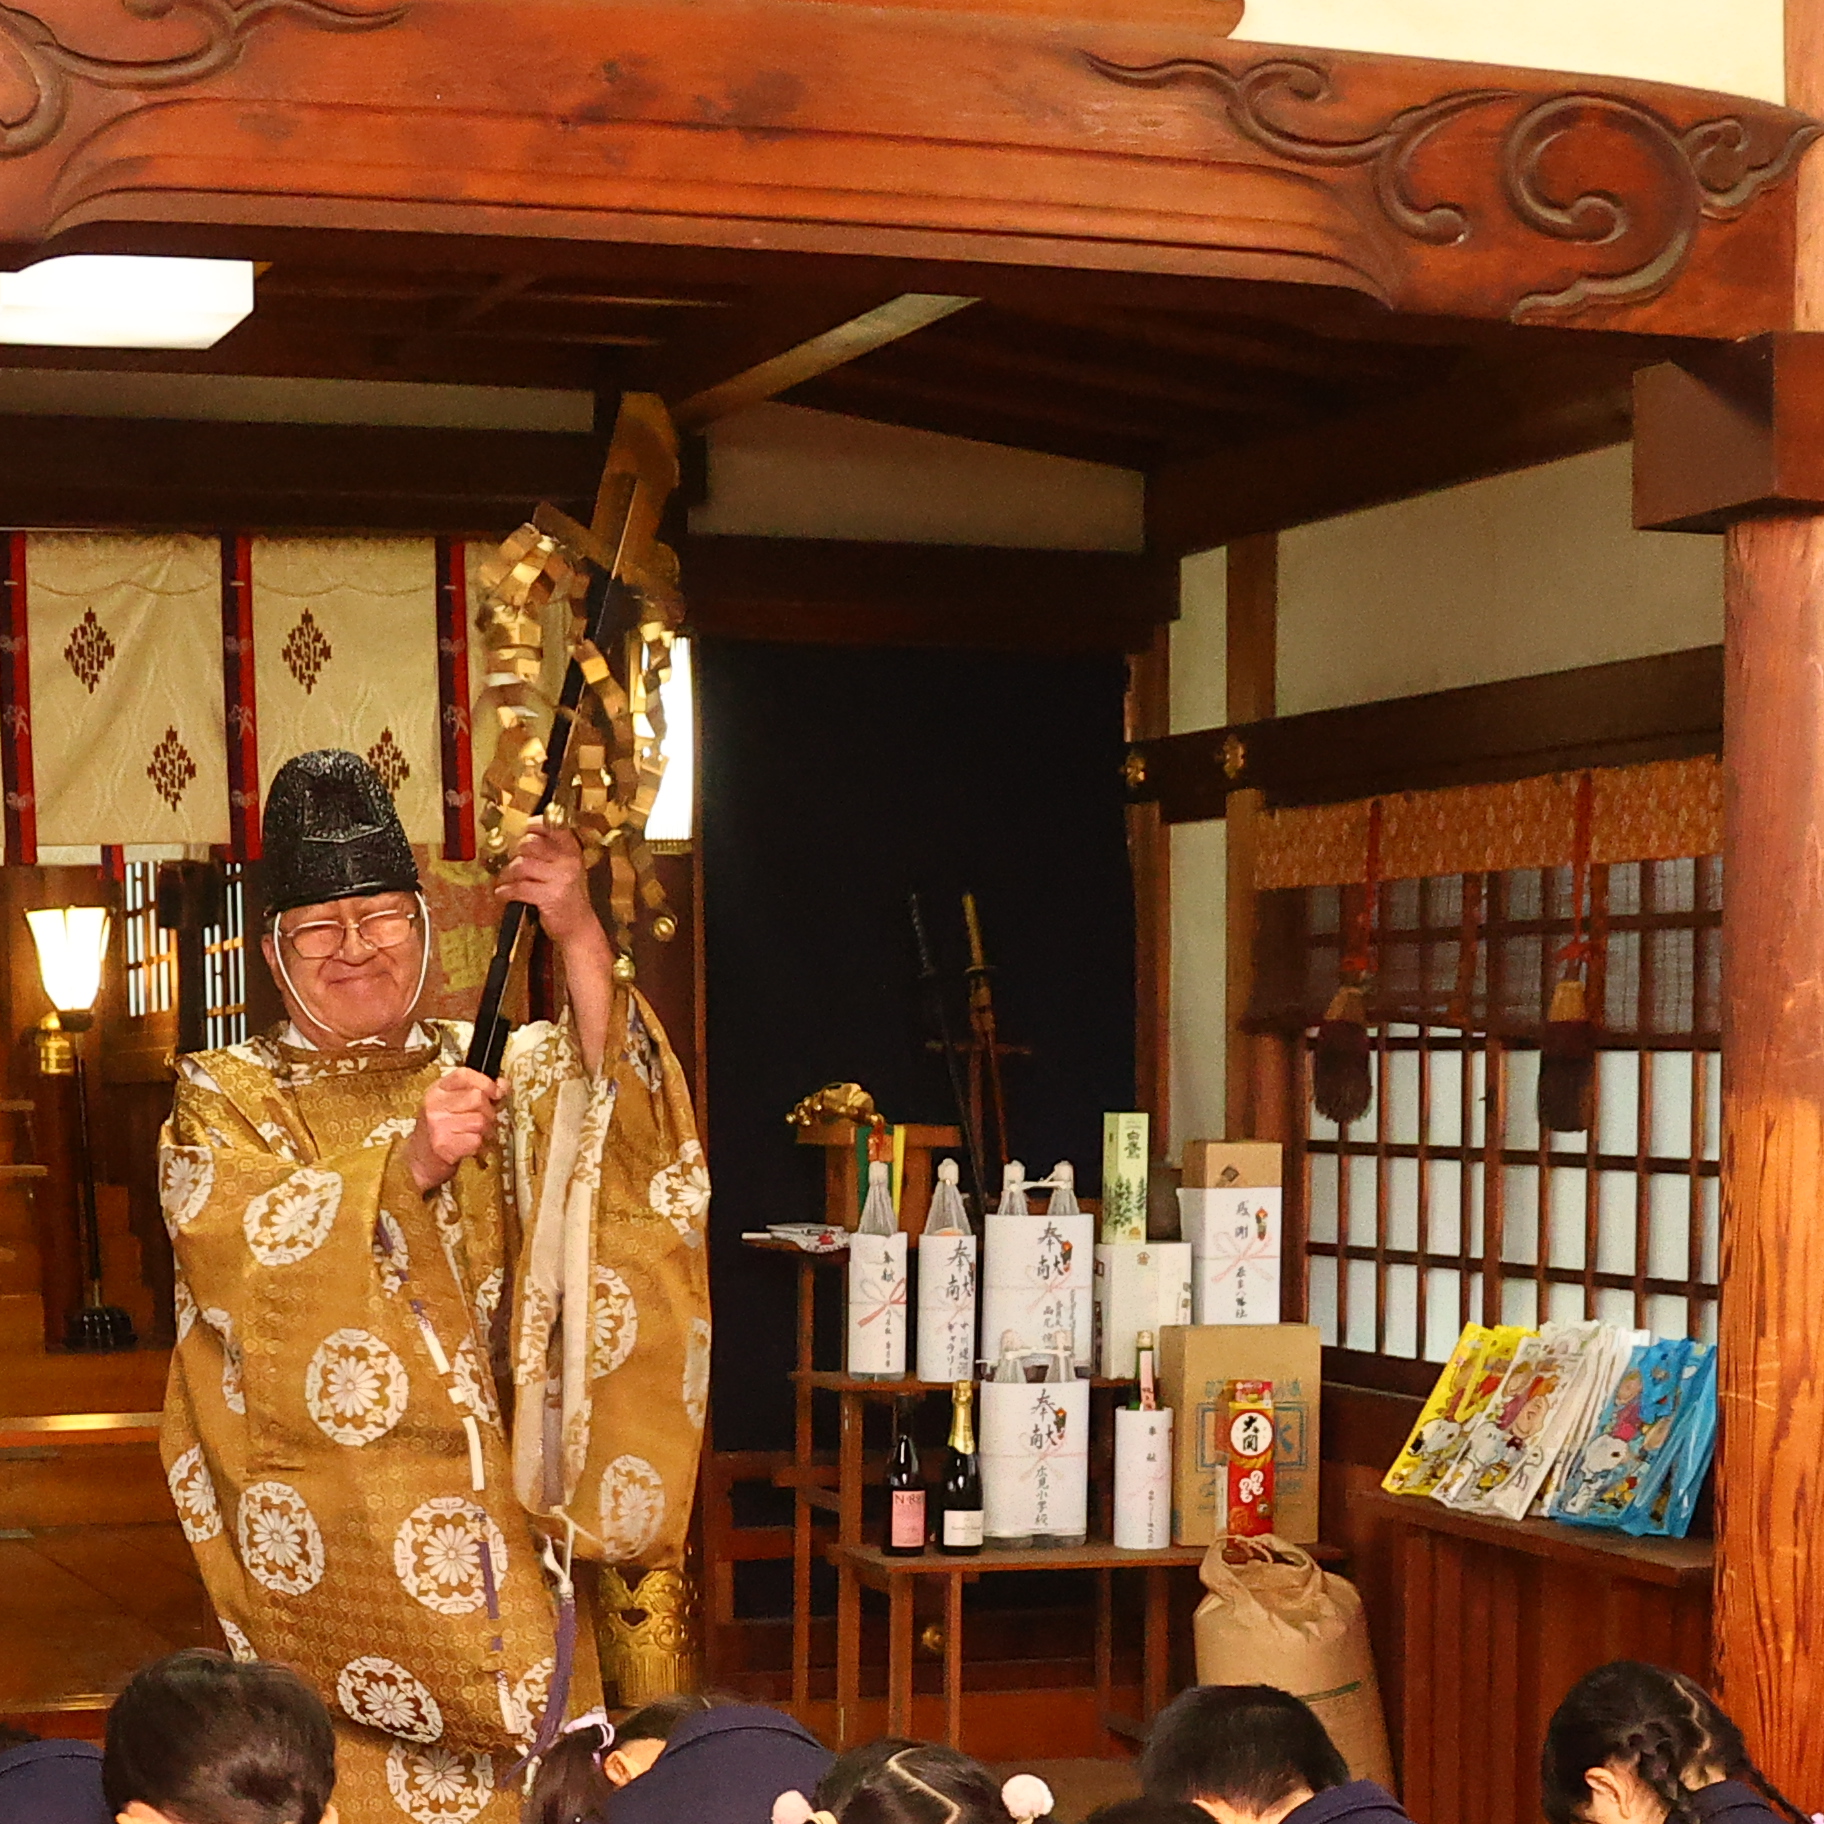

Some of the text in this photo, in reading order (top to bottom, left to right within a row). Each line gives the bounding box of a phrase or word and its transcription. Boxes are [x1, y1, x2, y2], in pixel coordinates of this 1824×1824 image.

[945, 1239, 972, 1301] 奉献
[1037, 1221, 1064, 1280] 奉献
[1031, 1388, 1058, 1449] 奉献
[1242, 1415, 1260, 1452] 大関
